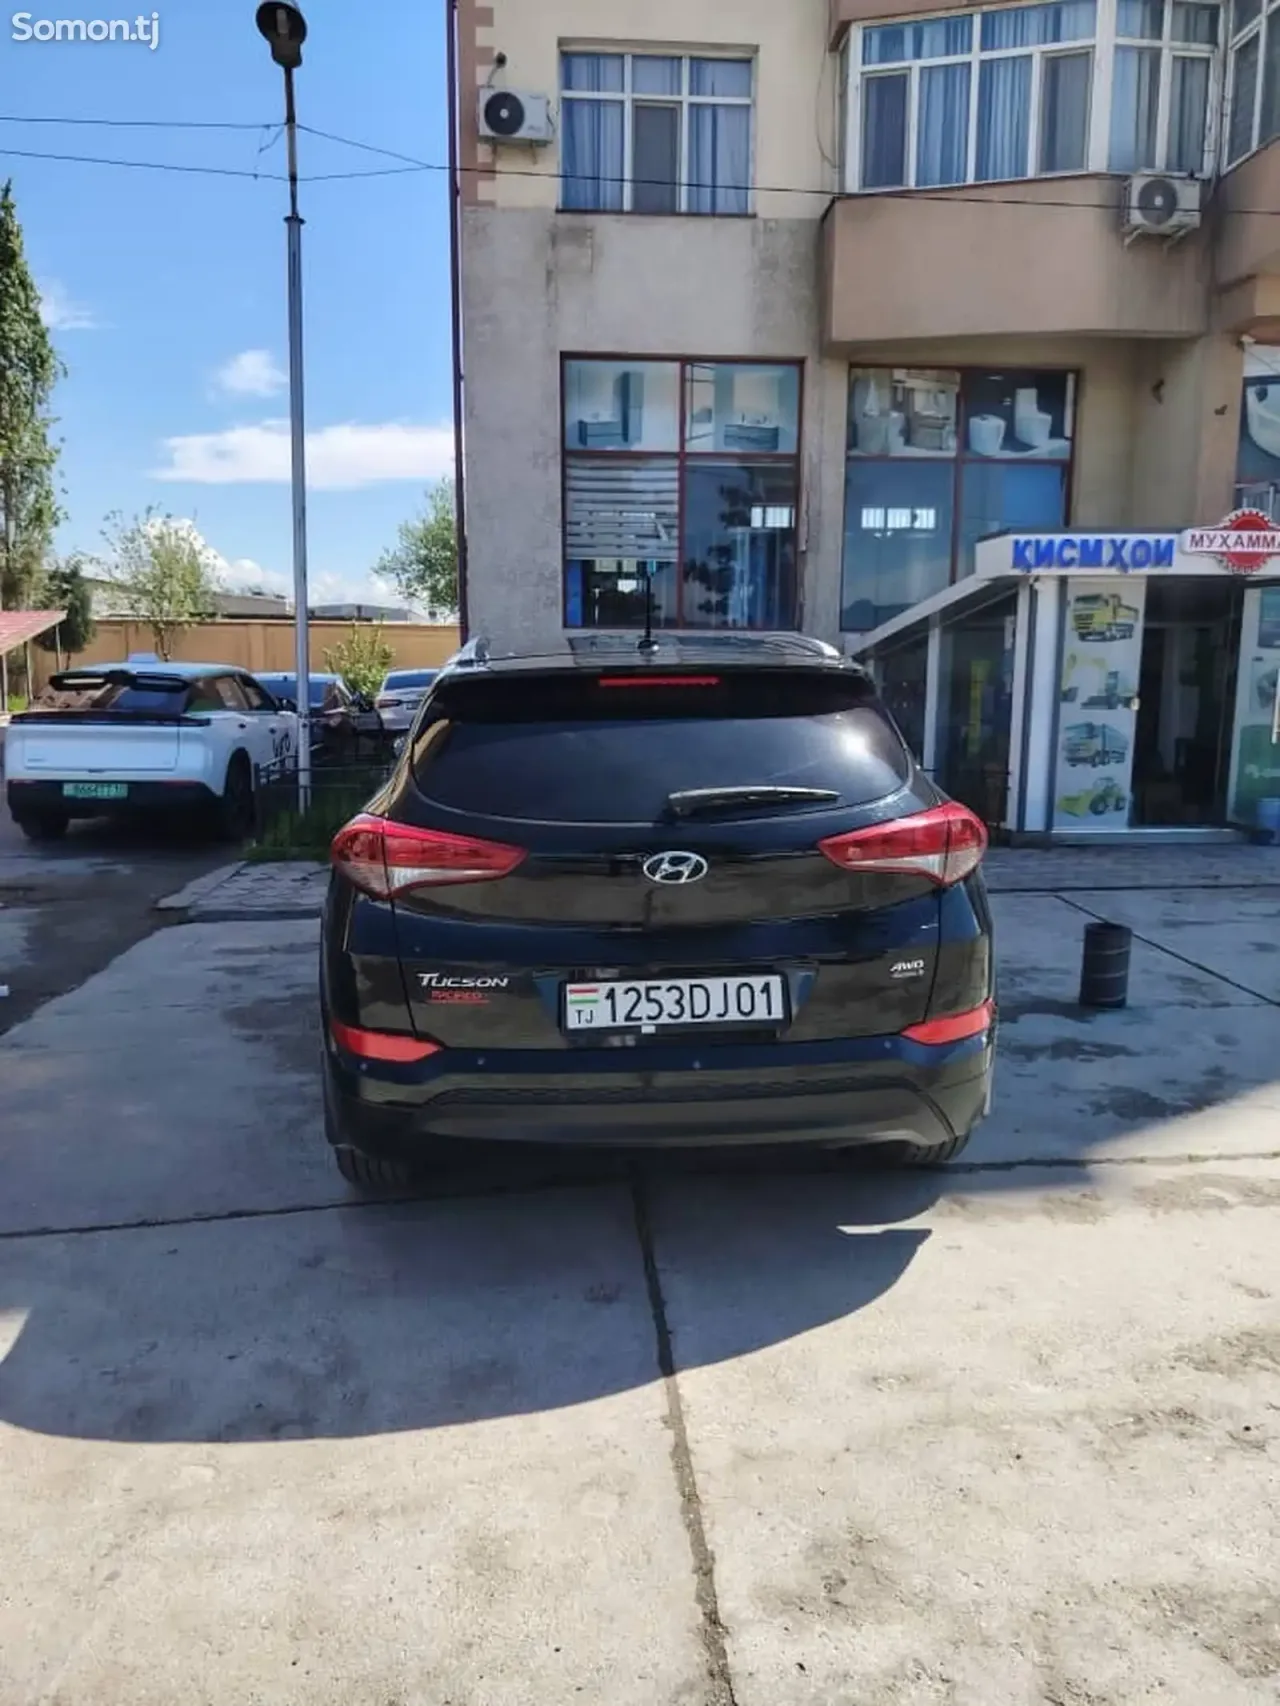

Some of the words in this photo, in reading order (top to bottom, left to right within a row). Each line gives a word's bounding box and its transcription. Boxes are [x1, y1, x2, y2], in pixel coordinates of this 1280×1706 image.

[1189, 533, 1280, 549] МУҲАММ
[1011, 538, 1176, 574] ҚИСМҲОИ
[604, 981, 775, 1023] 1253DJ01
[575, 1009, 594, 1025] TJ
